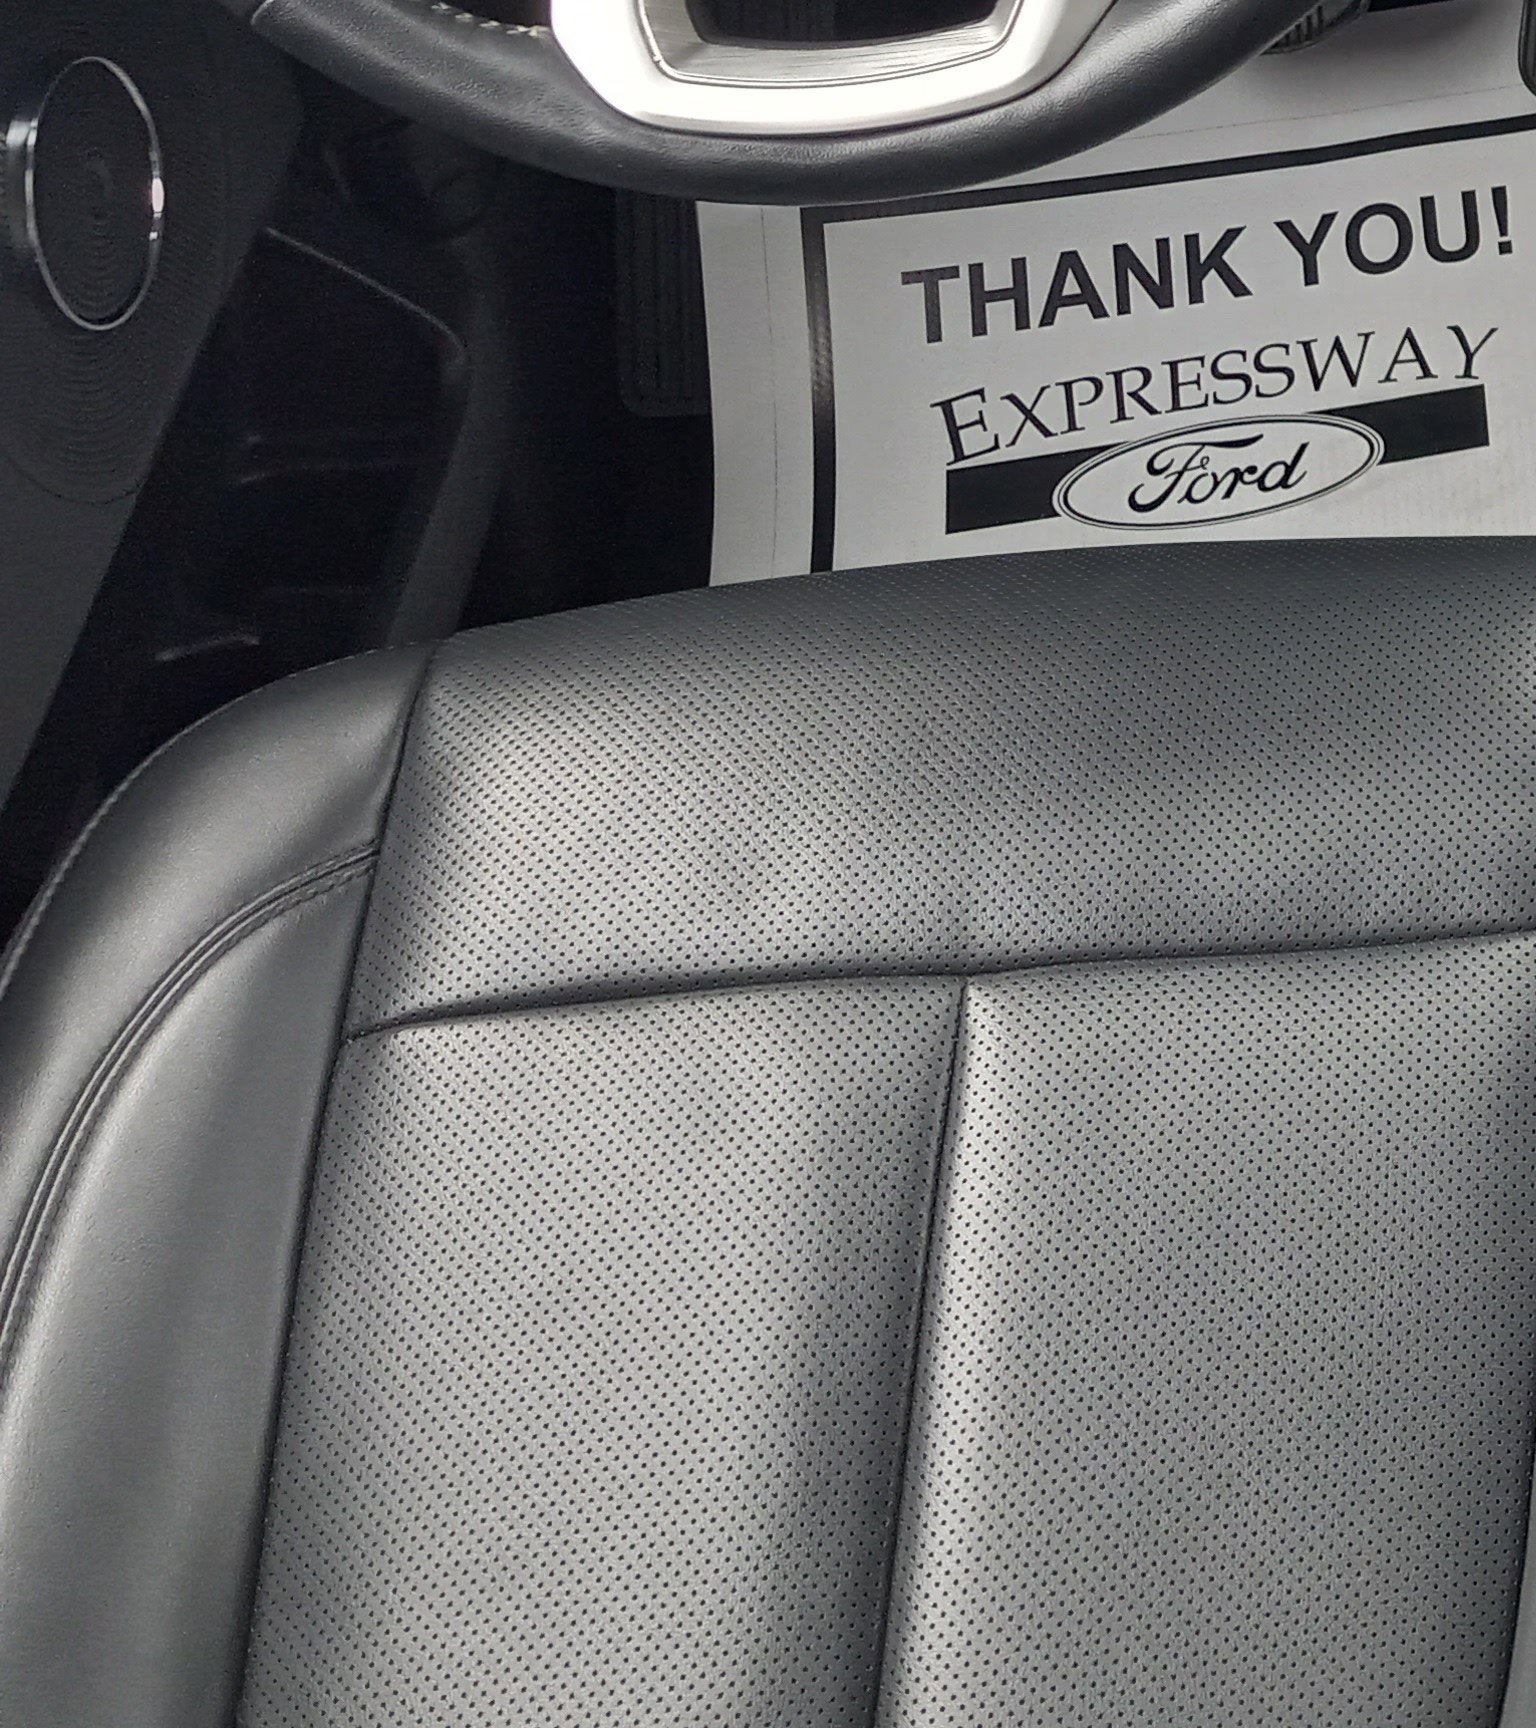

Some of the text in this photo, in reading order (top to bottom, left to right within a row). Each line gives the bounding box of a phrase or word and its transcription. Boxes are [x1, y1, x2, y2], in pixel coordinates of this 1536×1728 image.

[902, 185, 1515, 345] THANK YOU!
[930, 324, 1500, 467] EXPRESSWAY
[1127, 434, 1308, 515] Ford
